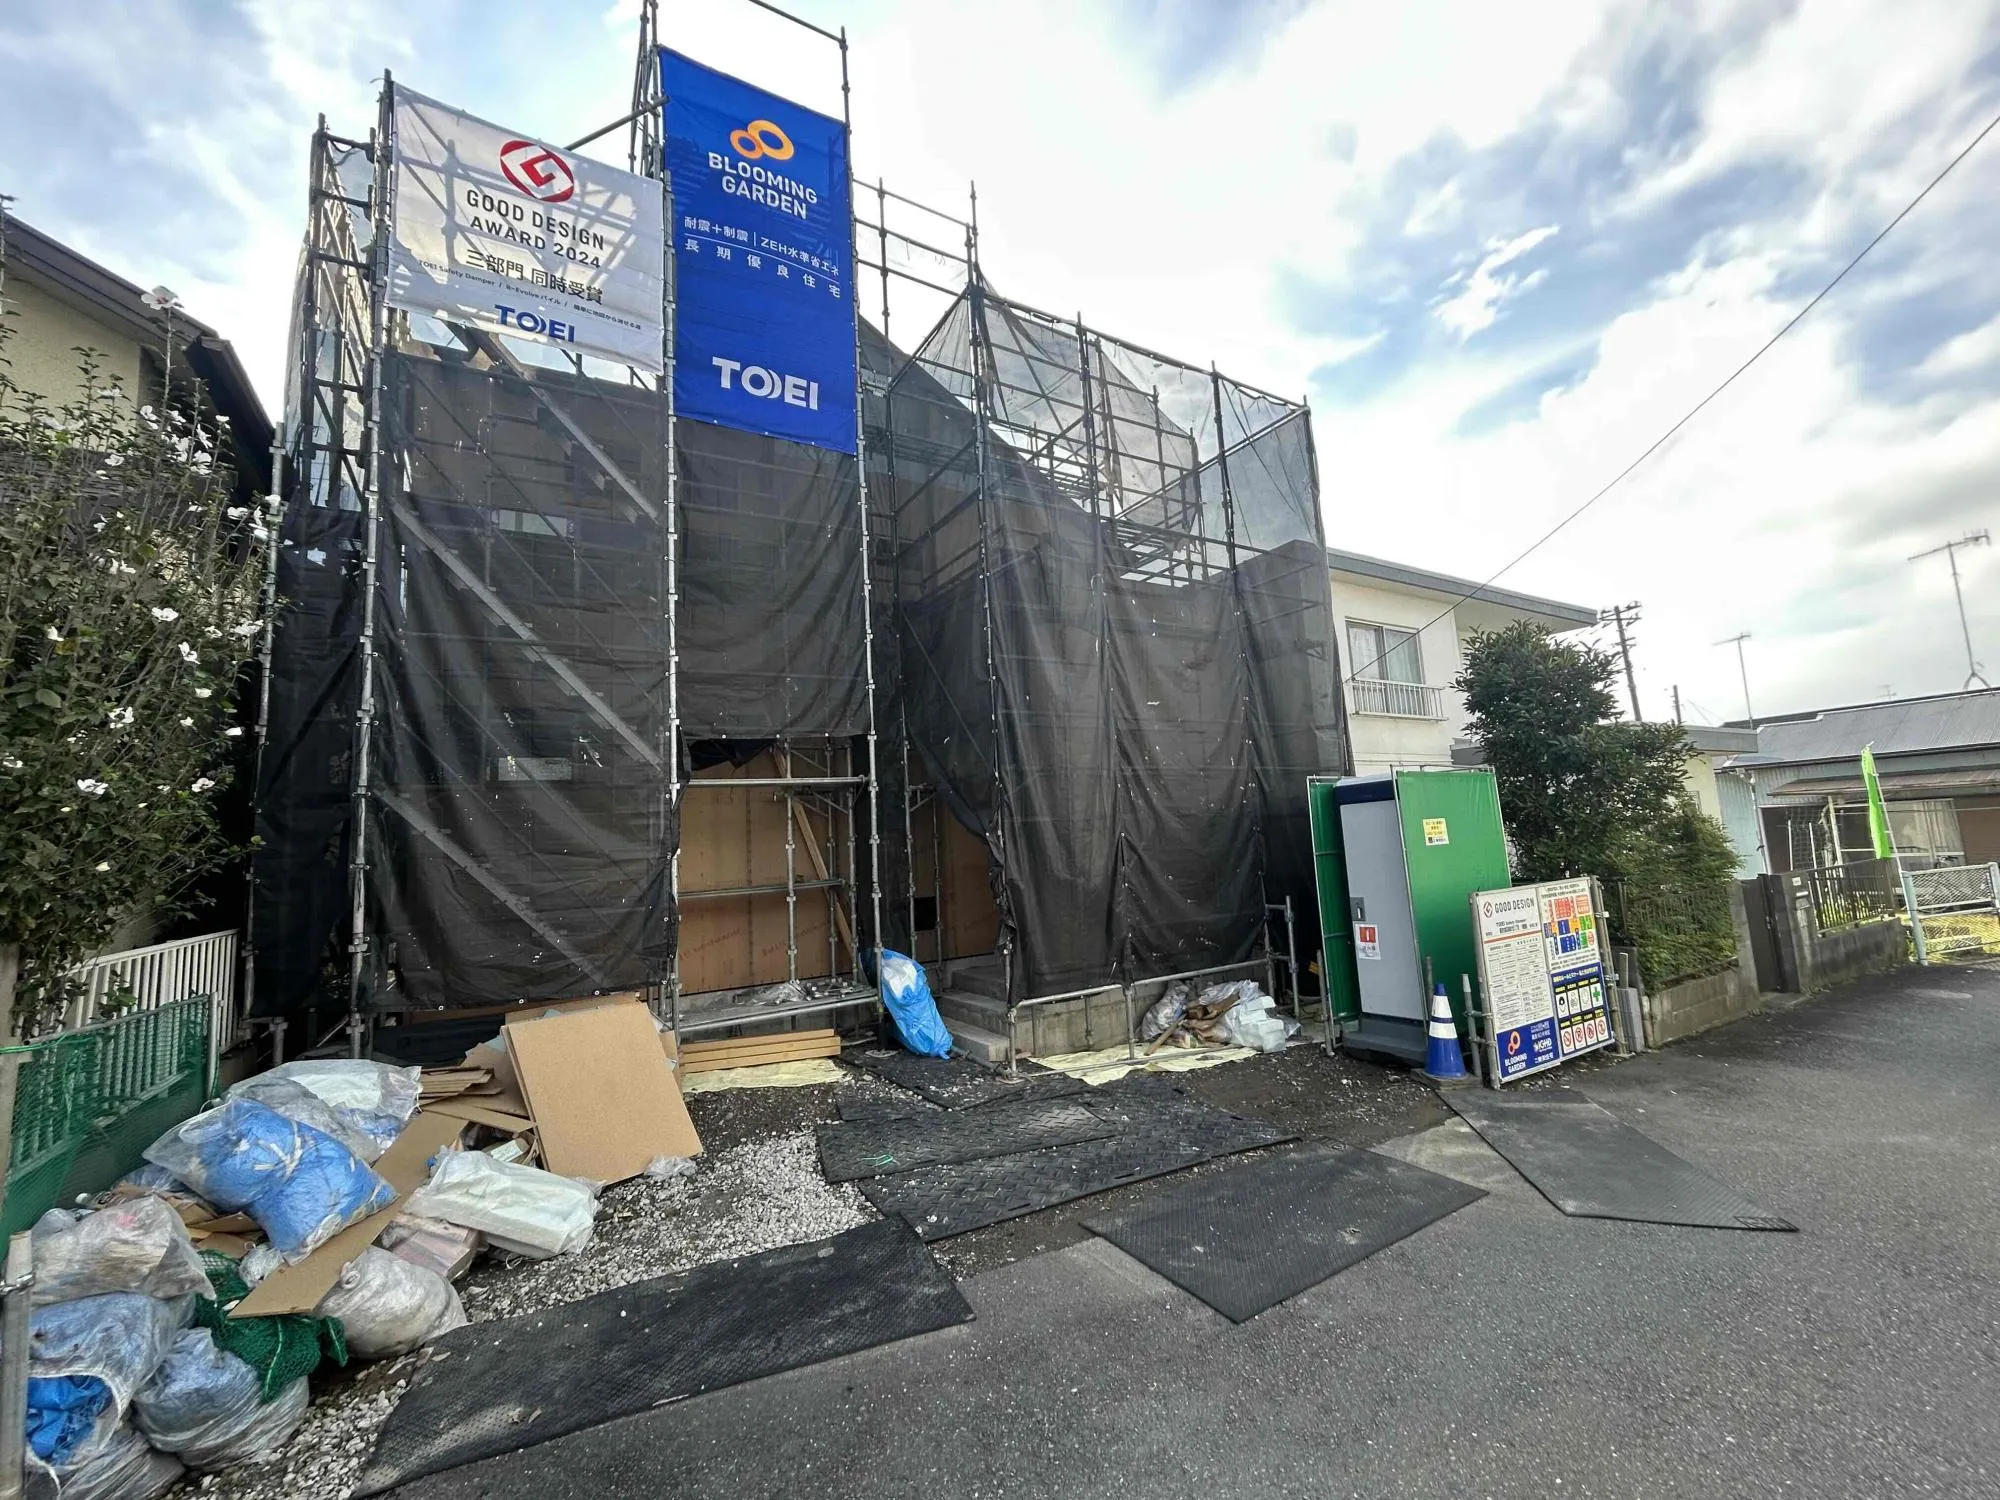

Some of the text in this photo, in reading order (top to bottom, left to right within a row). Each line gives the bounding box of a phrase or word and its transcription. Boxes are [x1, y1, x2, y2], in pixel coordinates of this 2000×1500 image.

[708, 151, 817, 204] BLOOMING
[722, 175, 806, 220] GARDEN
[466, 189, 604, 250] GOOD DESIGN
[470, 216, 601, 269] AWARD 2024
[465, 272, 495, 286] Damper
[466, 249, 603, 305] 三部門 同時受賞
[685, 238, 841, 298] 長期優良住宅
[760, 236, 839, 277] ZEH水準省エネ
[494, 303, 575, 343] TOEI
[712, 356, 819, 411] TOEI
[1494, 897, 1535, 913] GOOD DESIGN
